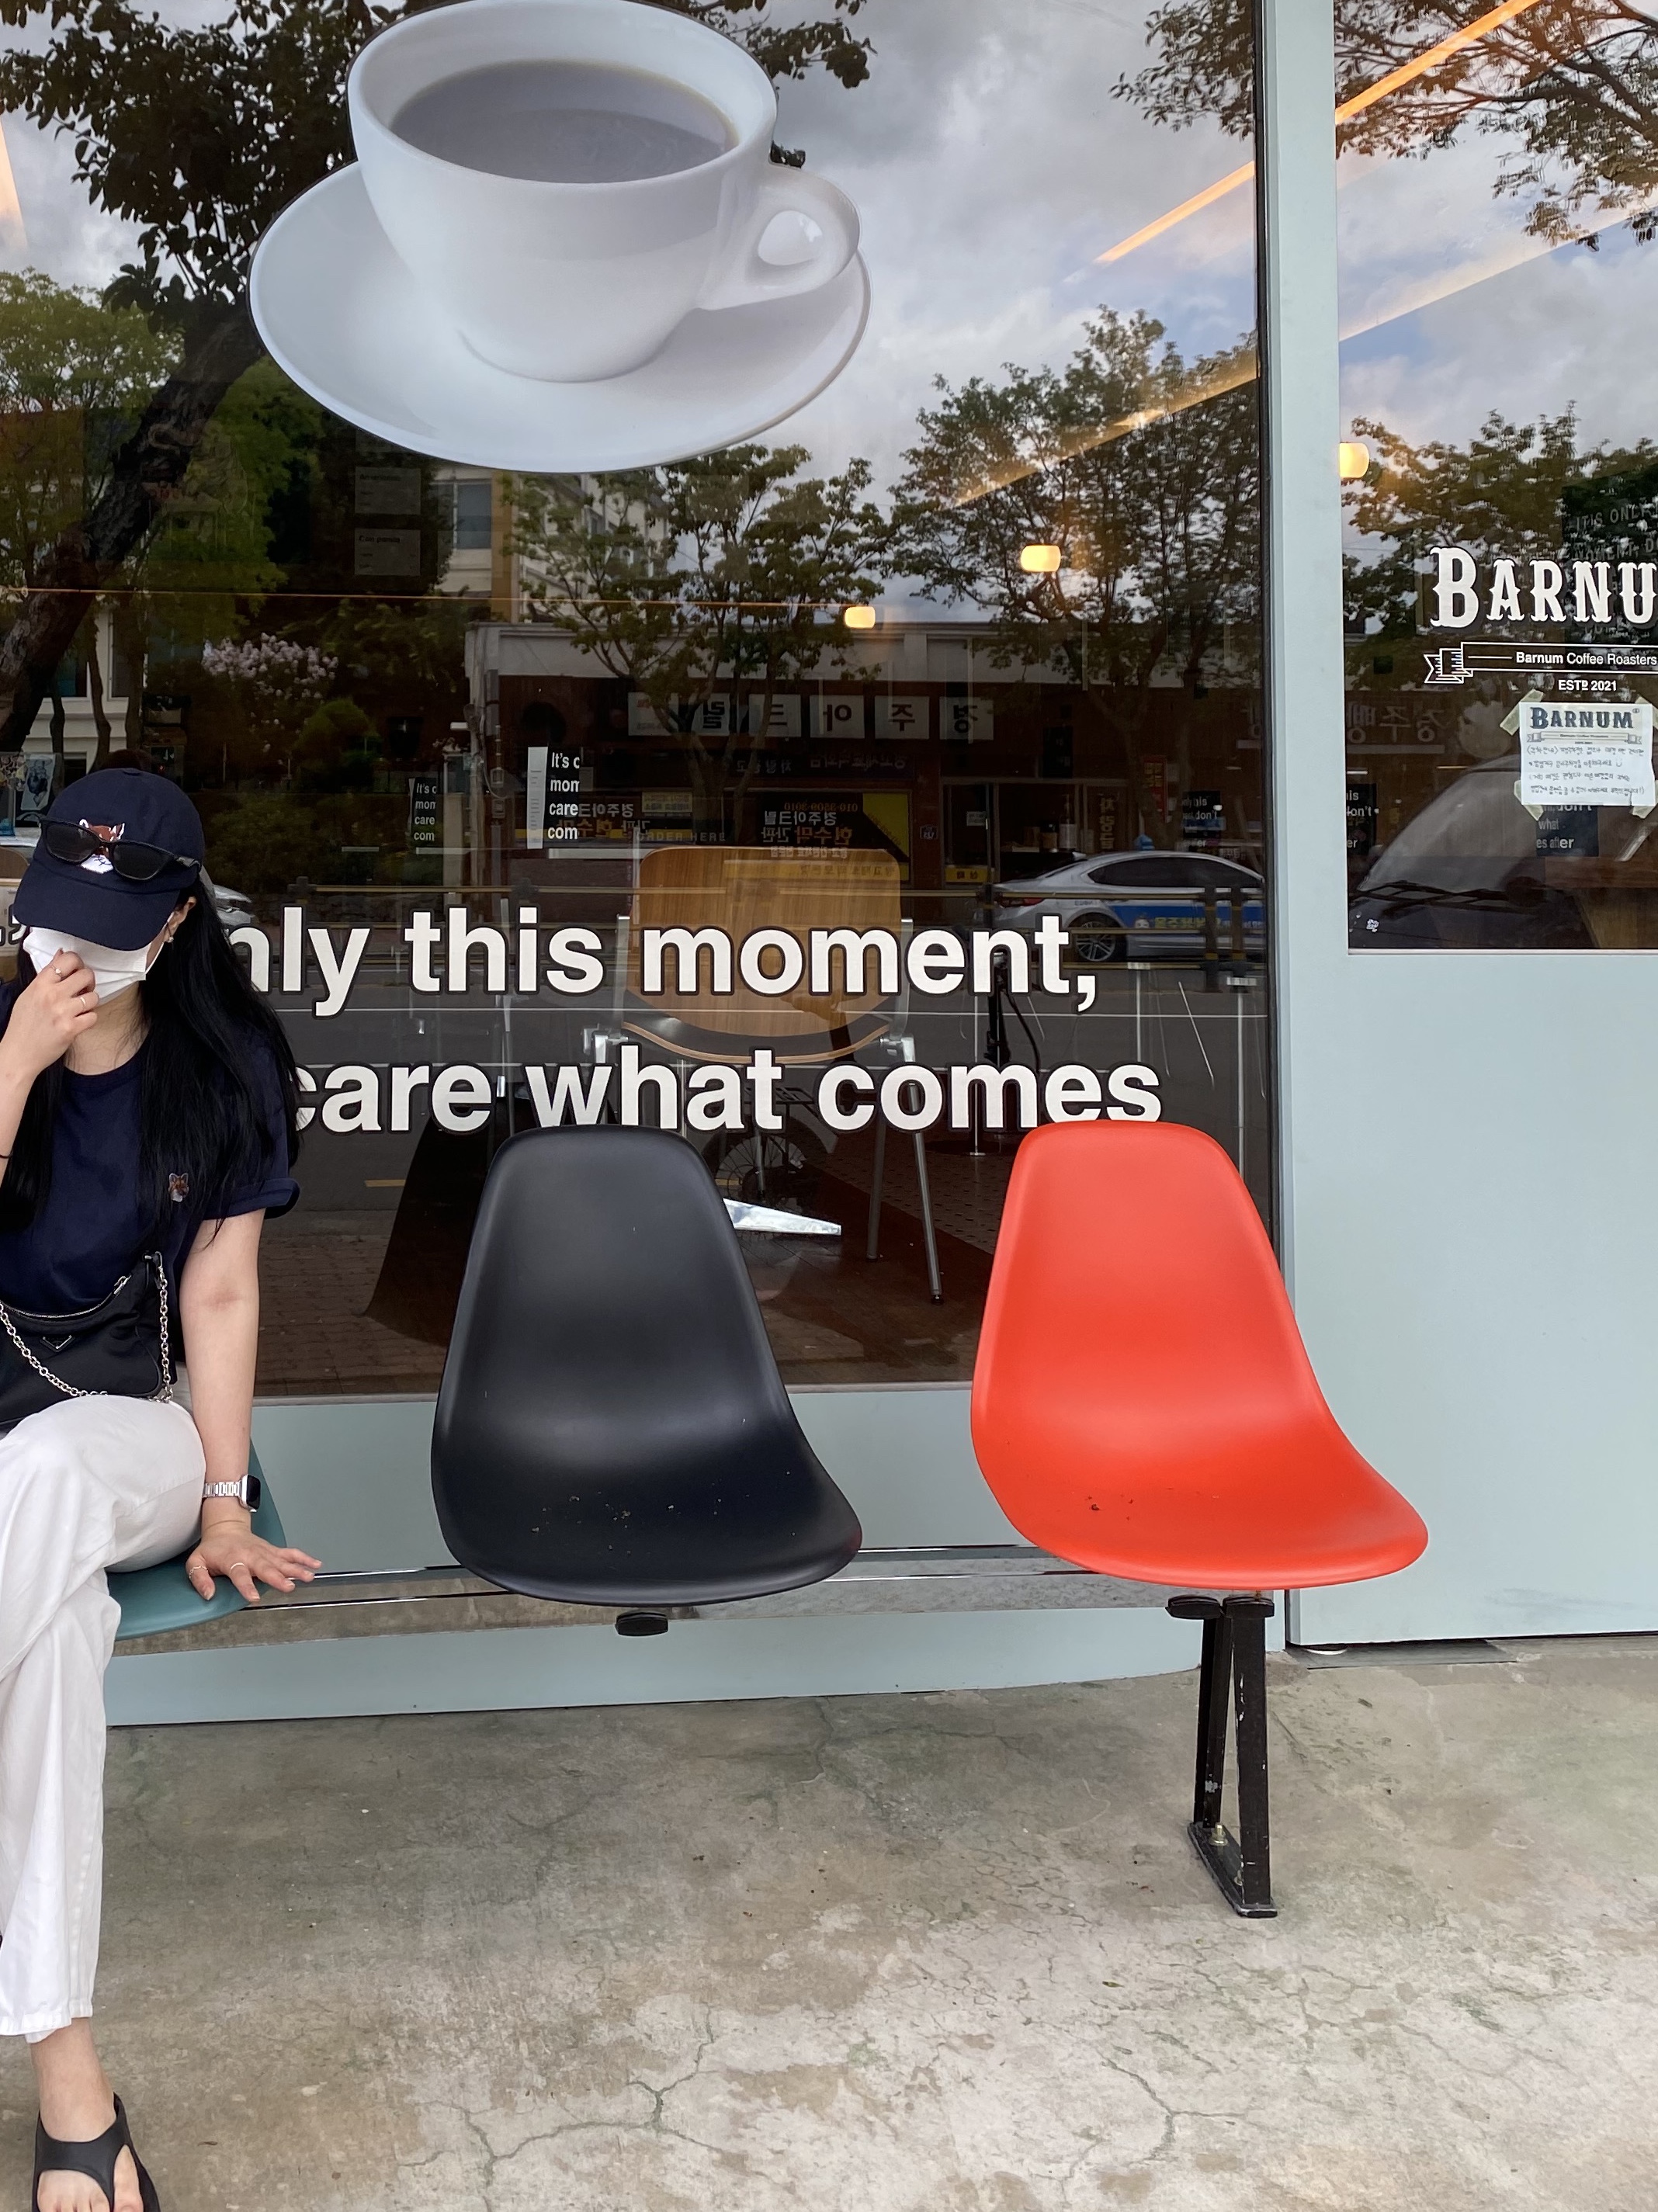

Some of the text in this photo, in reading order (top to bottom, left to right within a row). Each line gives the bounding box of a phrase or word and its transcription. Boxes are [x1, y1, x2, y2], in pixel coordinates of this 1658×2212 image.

[1516, 651, 1657, 665] Barnum Coffee Roasters
[1591, 680, 1618, 692] 2021
[549, 803, 579, 816] care
[414, 816, 435, 825] care
[226, 907, 1095, 1016] nly this moment,
[525, 1039, 784, 1131] what
[818, 1064, 1162, 1130] comes
